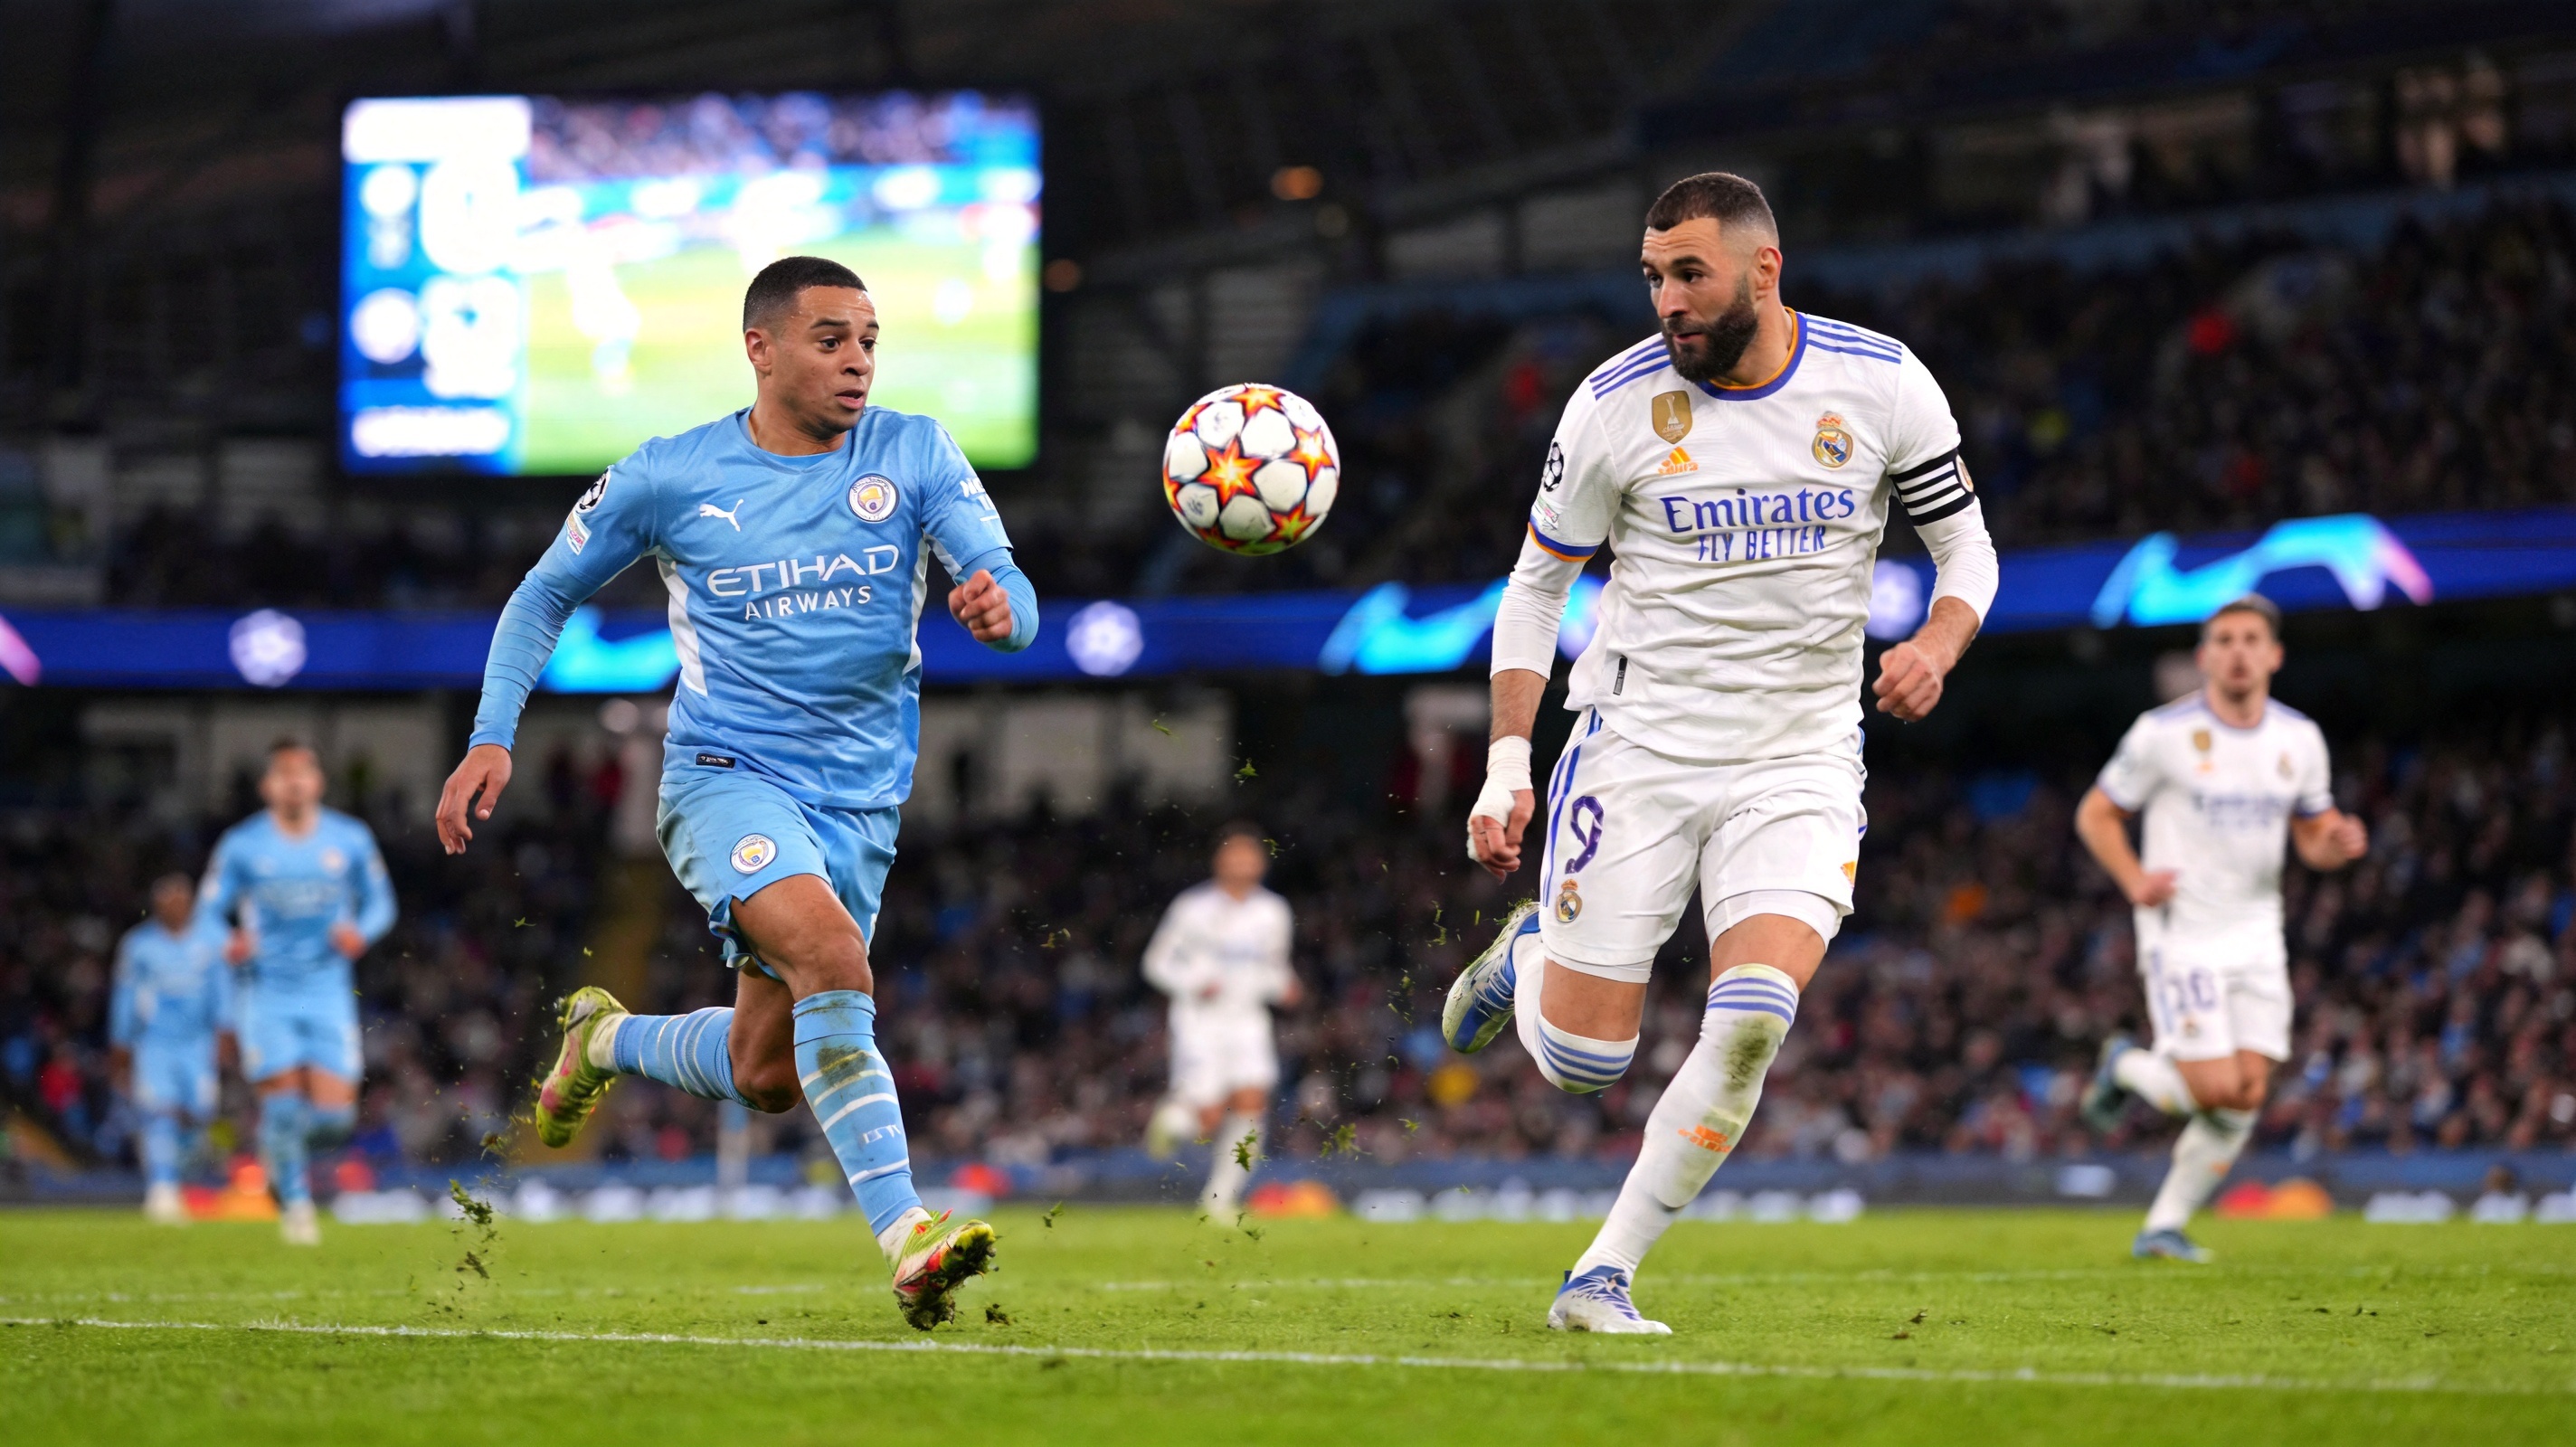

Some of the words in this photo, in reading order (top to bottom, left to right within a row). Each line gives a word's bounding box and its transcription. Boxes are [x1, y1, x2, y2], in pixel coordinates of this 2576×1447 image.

[1660, 487, 1855, 534] Emirates
[1697, 534, 1734, 562] FLY
[1745, 525, 1826, 561] BETTER
[706, 544, 899, 597] ETIHAD
[744, 586, 871, 620] AIRWAYS
[1565, 796, 1605, 875] 9
